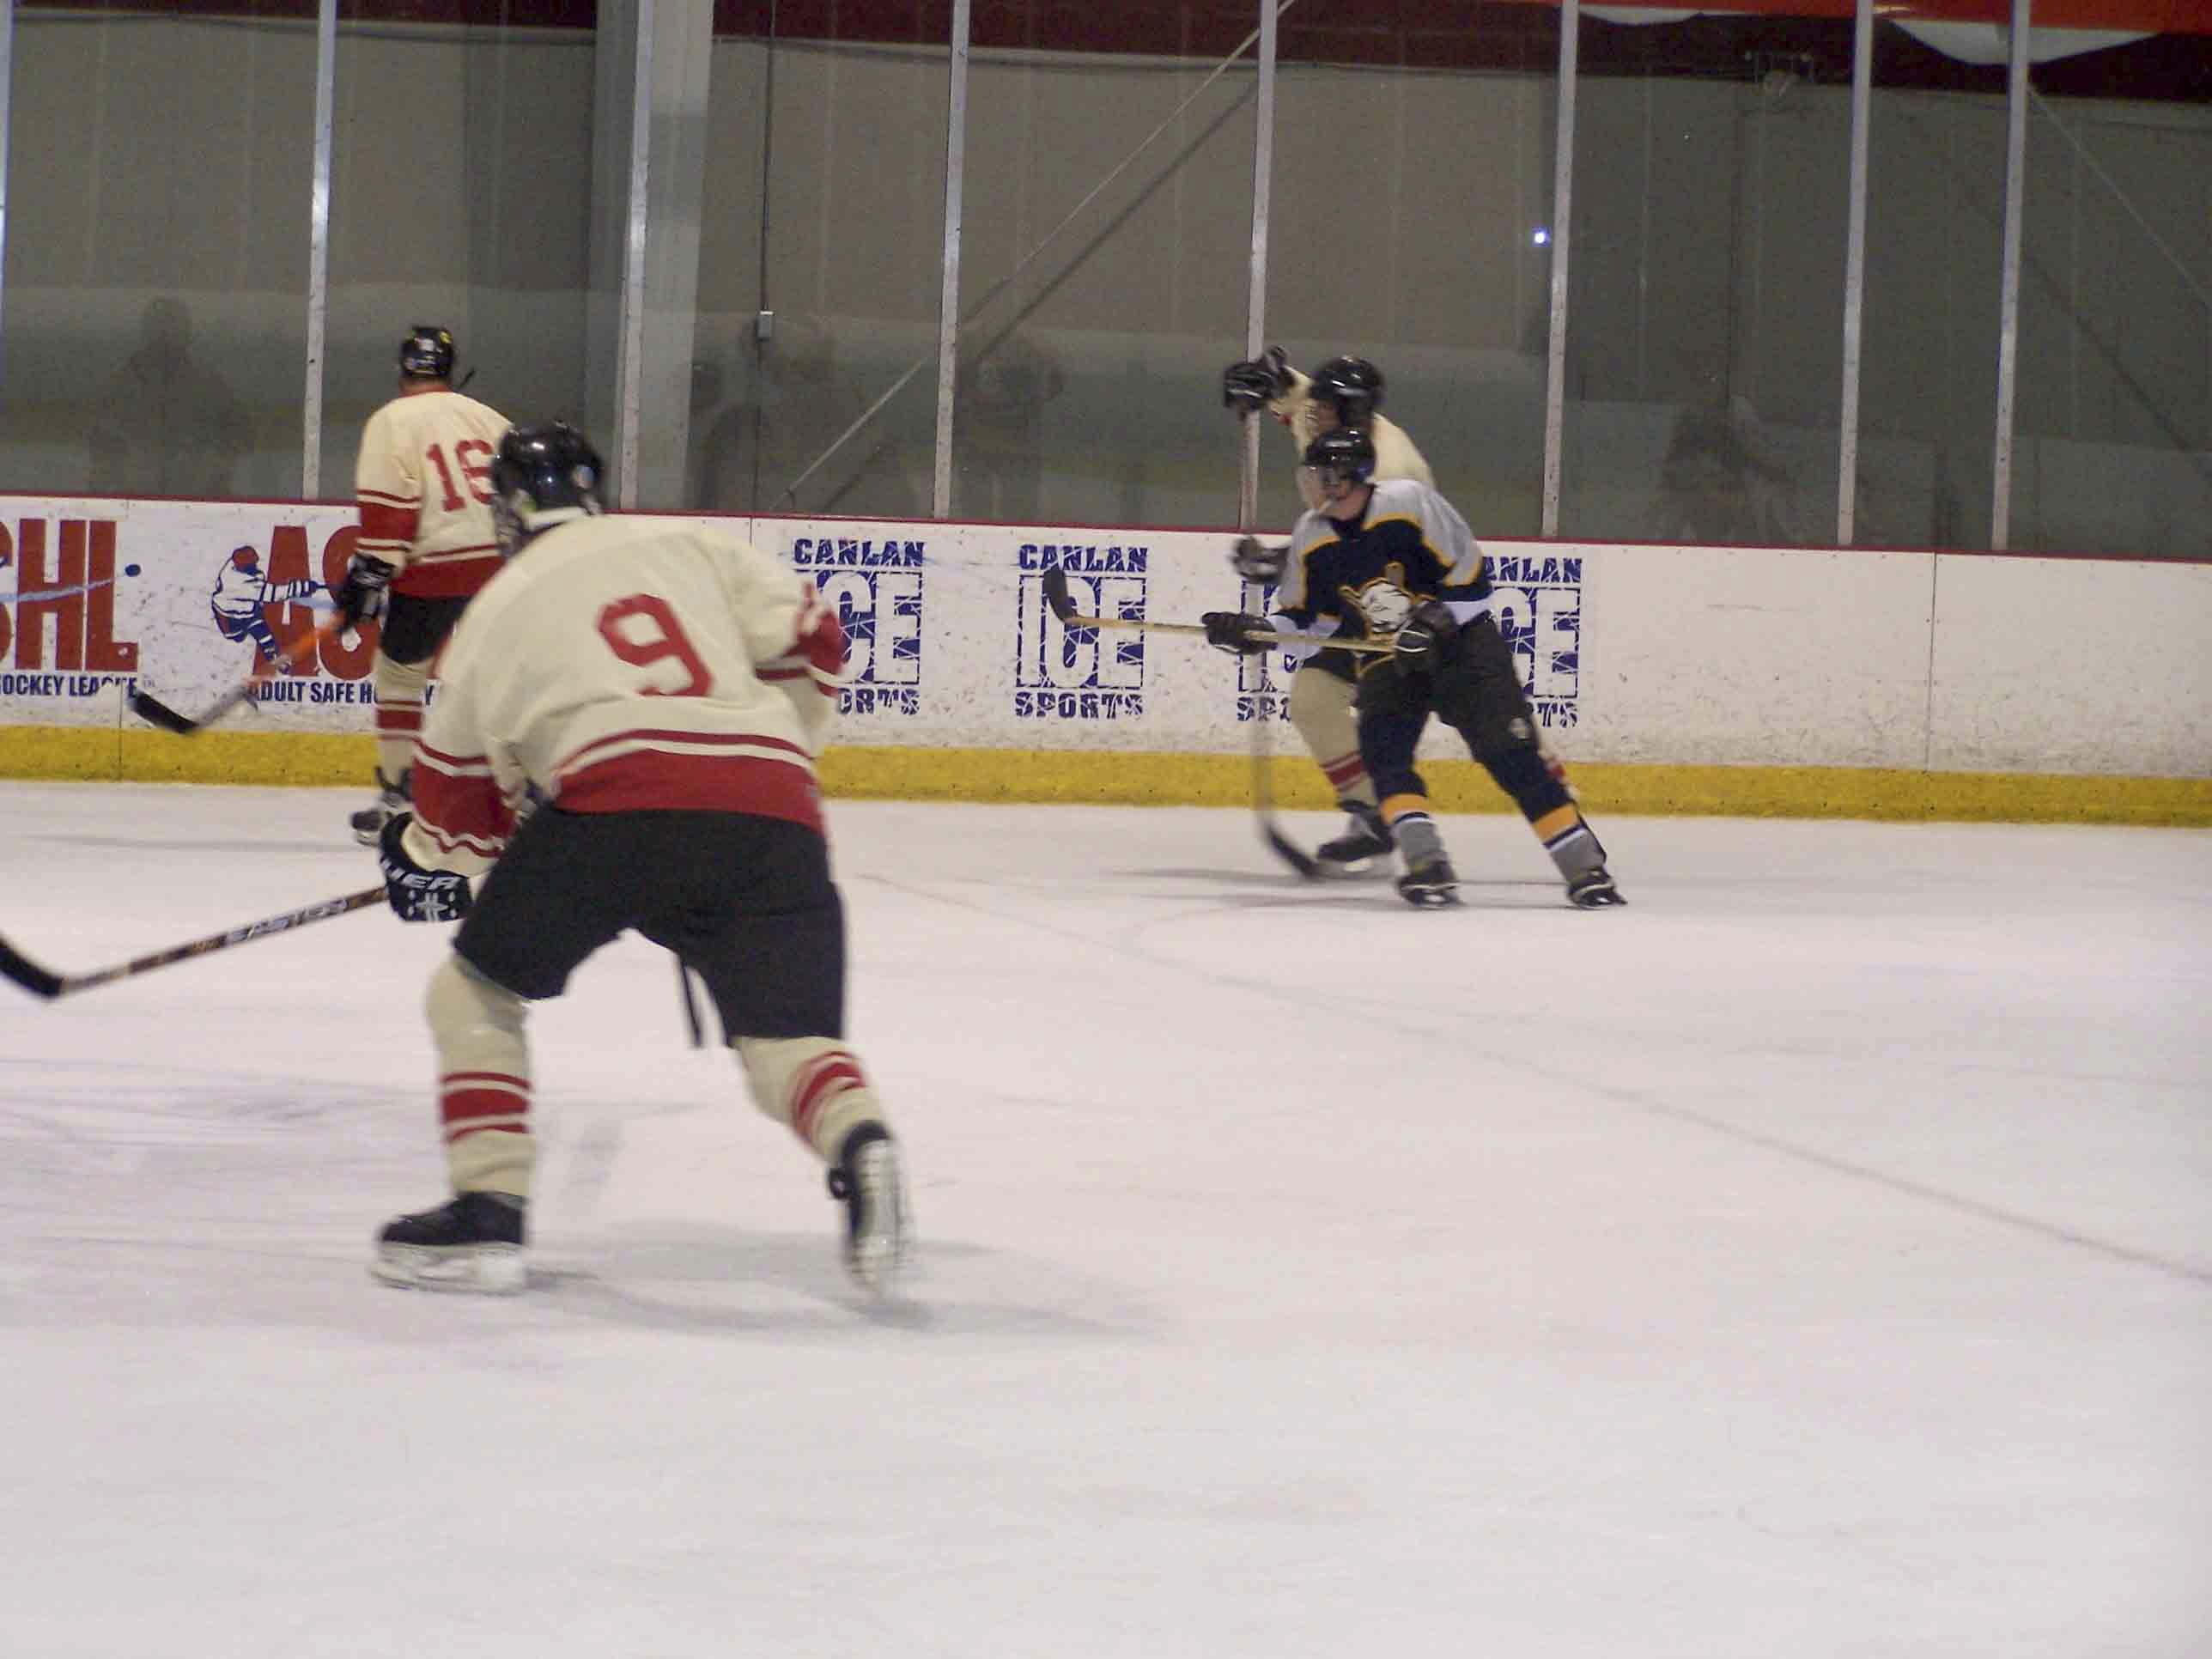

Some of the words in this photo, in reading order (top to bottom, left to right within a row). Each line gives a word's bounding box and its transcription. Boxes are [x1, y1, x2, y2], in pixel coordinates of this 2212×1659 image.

[794, 538, 925, 567] CANLAN
[1019, 544, 1148, 572] CANLAN
[1482, 556, 1583, 584] ANLAN
[0, 519, 138, 672] HL
[805, 569, 922, 686] CE
[597, 594, 713, 697] 9
[1486, 586, 1580, 699] CE
[0, 674, 64, 696] OCKEY
[69, 677, 137, 698] LEAE
[258, 680, 306, 702] DULT
[310, 681, 355, 703] SAFE
[837, 688, 921, 715] ORTS
[1015, 691, 1144, 720] SPORTS
